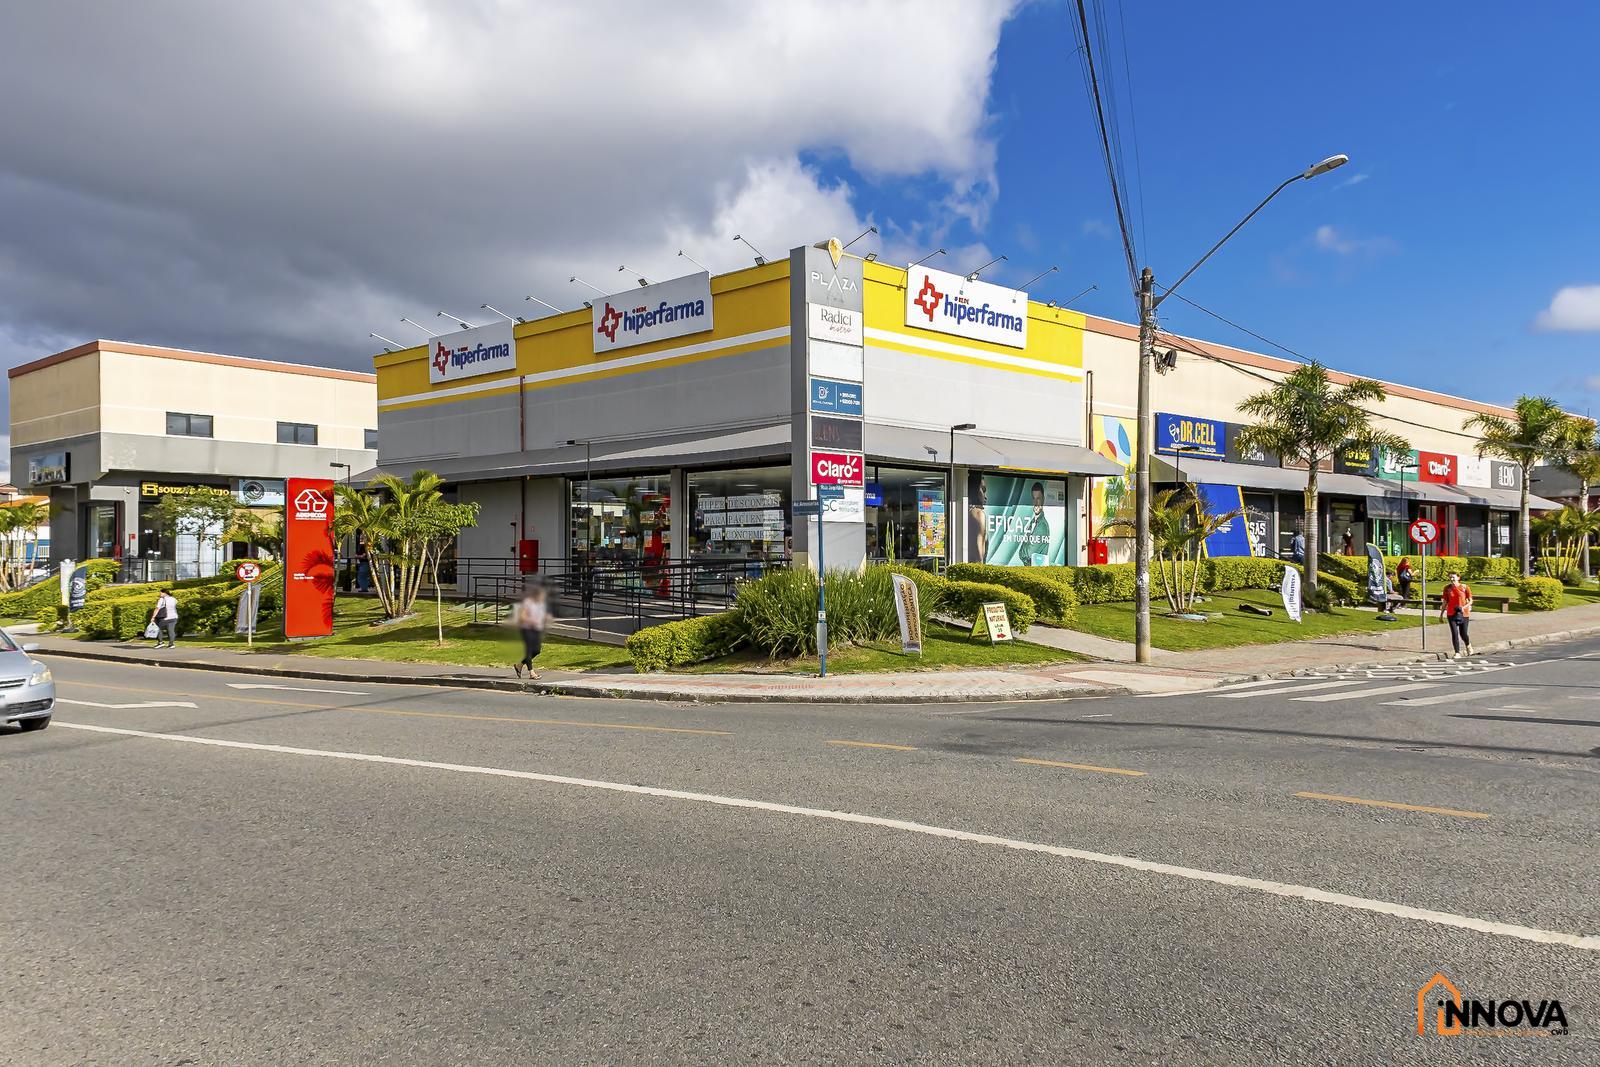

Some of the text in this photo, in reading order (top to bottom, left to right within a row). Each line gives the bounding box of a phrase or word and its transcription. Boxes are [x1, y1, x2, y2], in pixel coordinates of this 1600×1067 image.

[811, 271, 858, 293] PLAZA
[623, 300, 705, 335] hiperfarma
[820, 308, 852, 326] Radici
[943, 294, 1023, 333] hiperfarma
[451, 343, 510, 370] hiperfarma
[1180, 420, 1217, 446] DR.CELL
[817, 459, 853, 478] Claro
[1428, 461, 1448, 476] Claro
[988, 515, 1033, 533] EFICAZ
[1015, 535, 1028, 544] TUDO
[1030, 535, 1041, 544] QUE
